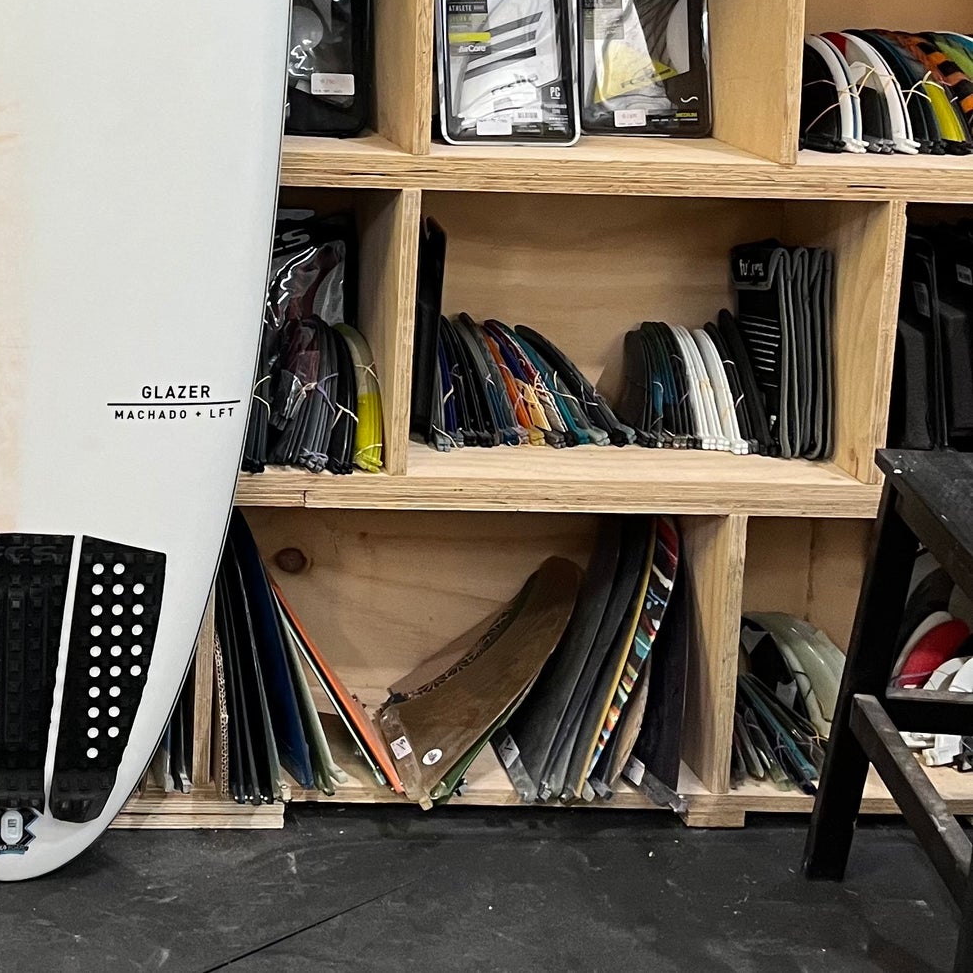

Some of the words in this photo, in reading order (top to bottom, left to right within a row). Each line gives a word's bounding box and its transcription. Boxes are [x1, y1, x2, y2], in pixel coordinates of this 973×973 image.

[142, 385, 211, 399] GLAZER
[114, 410, 187, 420] MACHADO
[209, 407, 234, 418] LFT
